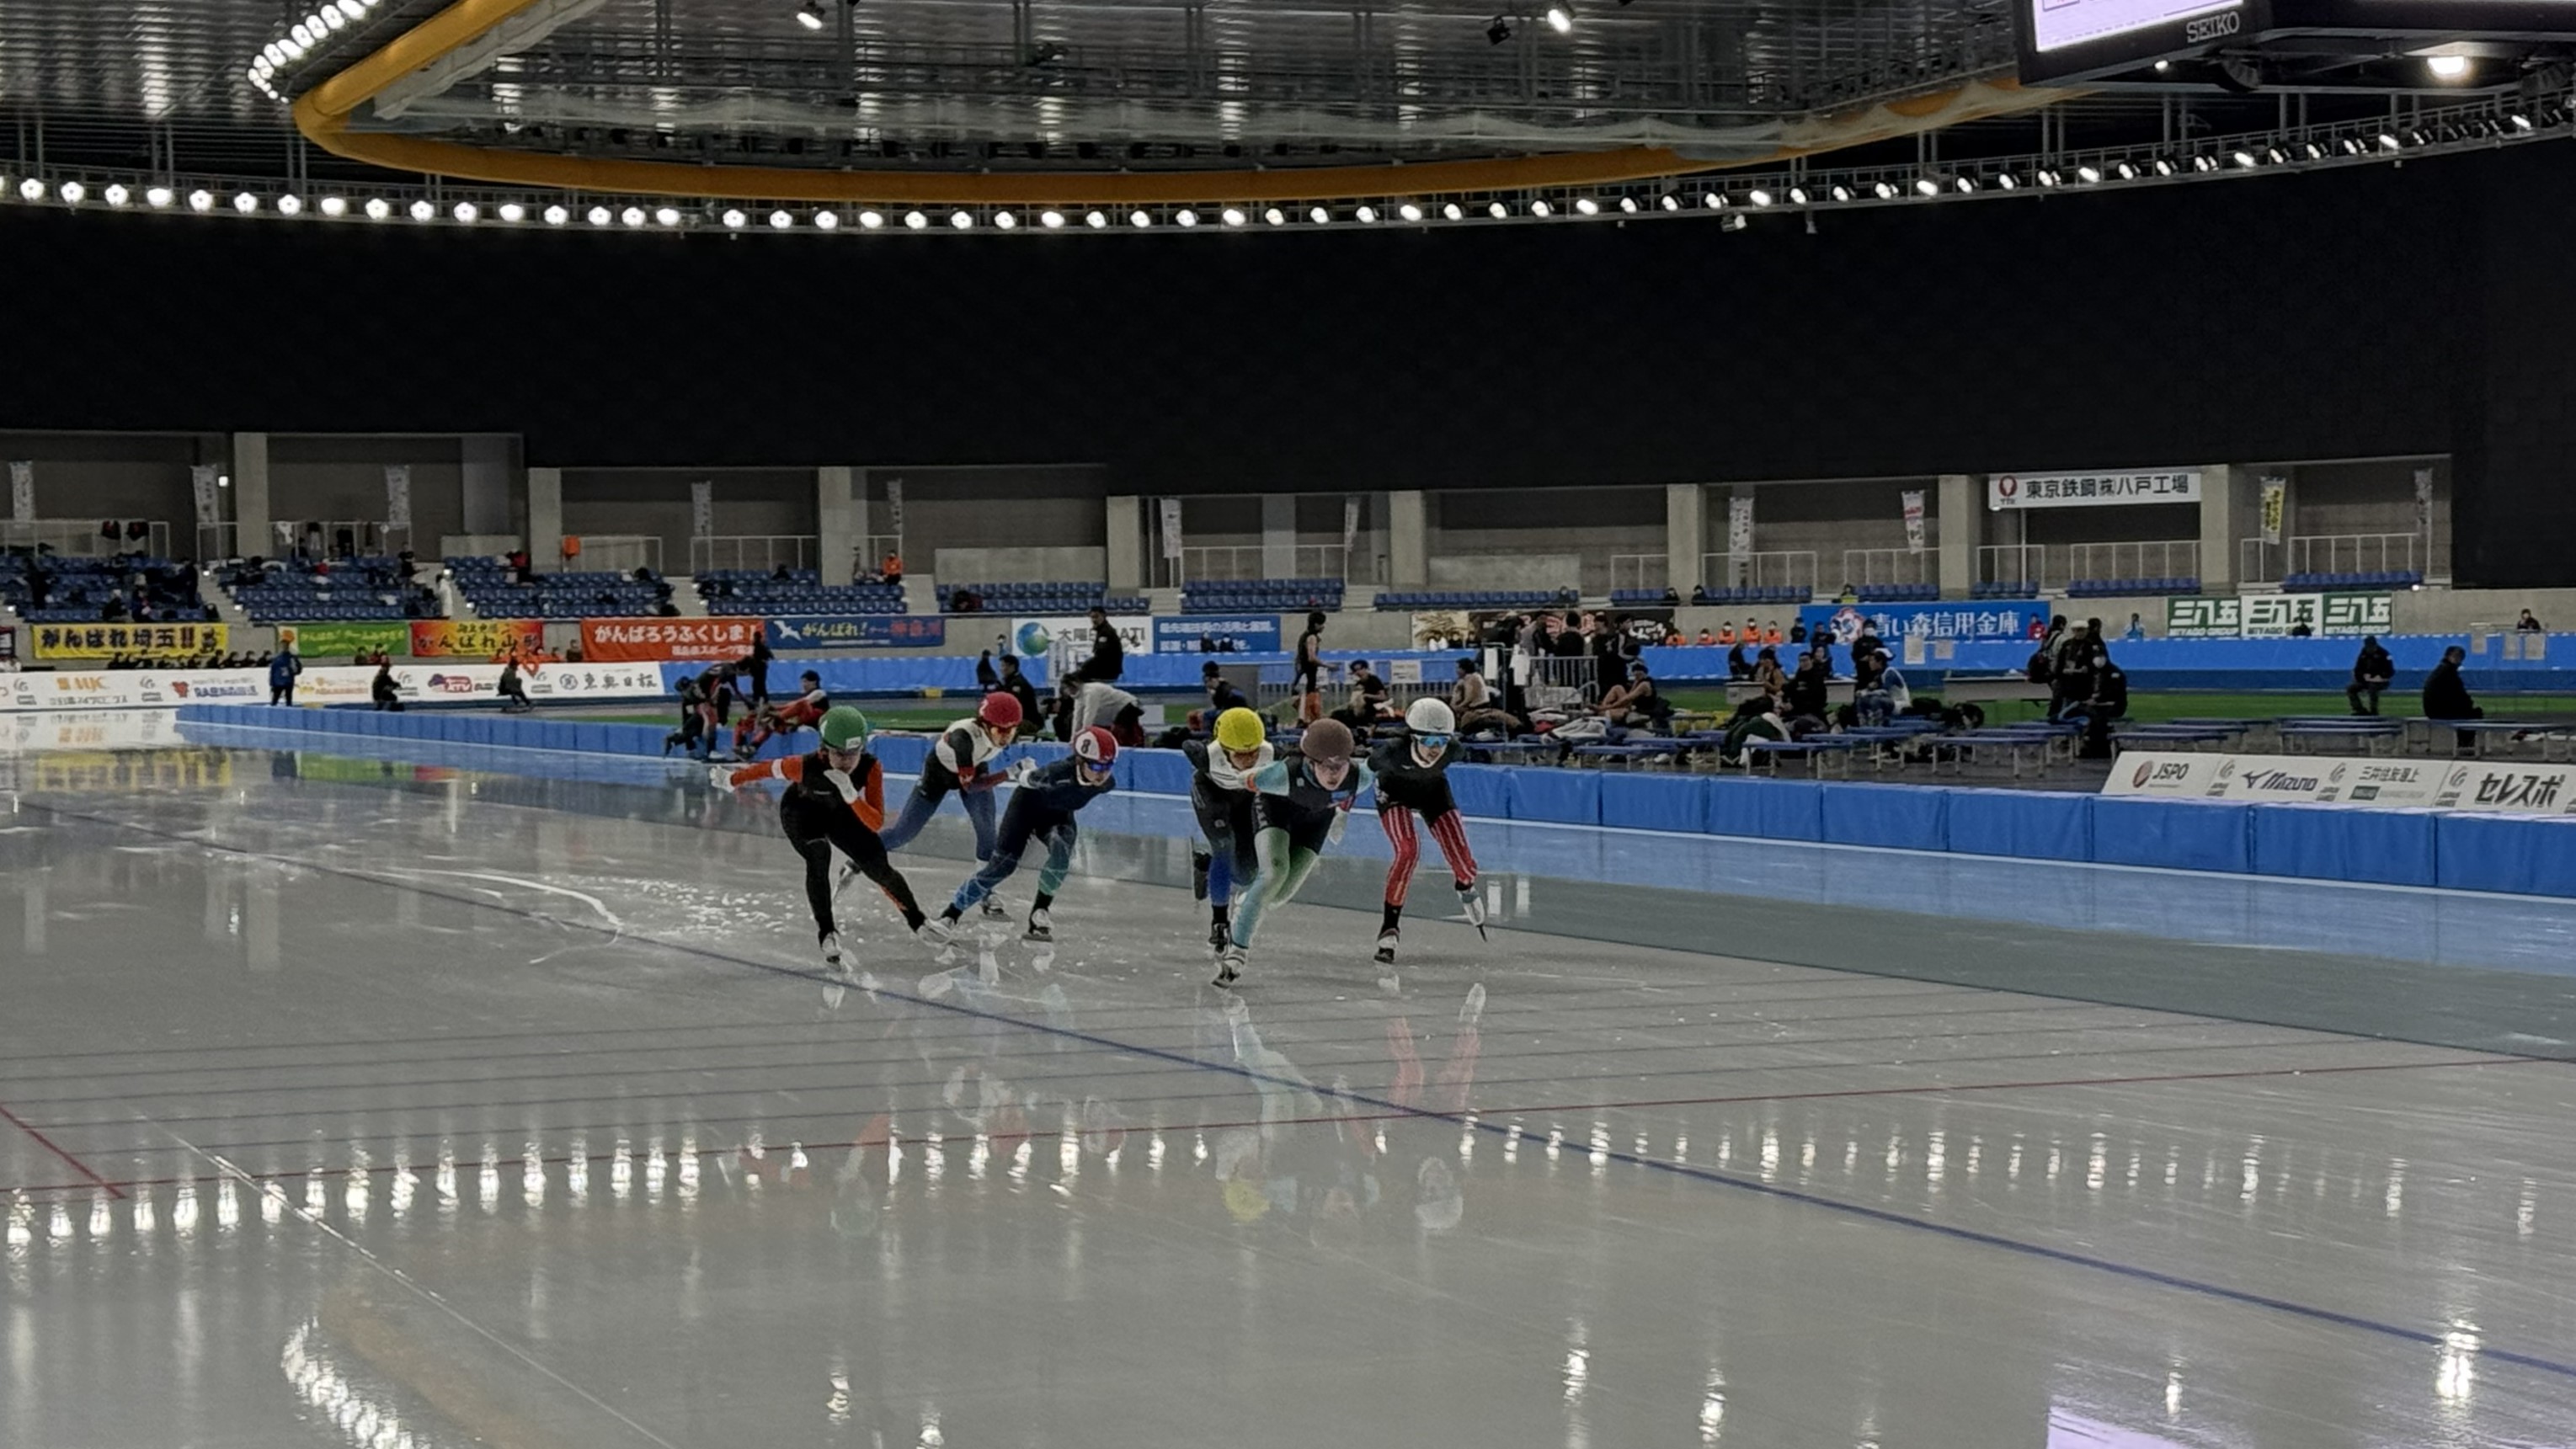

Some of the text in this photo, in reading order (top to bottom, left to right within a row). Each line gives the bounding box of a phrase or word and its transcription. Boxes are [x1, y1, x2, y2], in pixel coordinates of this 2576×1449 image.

[2186, 12, 2240, 42] SEIKO
[2170, 599, 2239, 626] 三八五
[2248, 599, 2316, 624] 三八五
[2325, 597, 2392, 623] 三八五
[1871, 610, 2021, 638] 青い森信用金庫
[584, 672, 657, 690] 東奥日報
[1080, 739, 1091, 754] 8
[2152, 763, 2189, 780] JSPO
[2475, 764, 2566, 807] セレスポ
